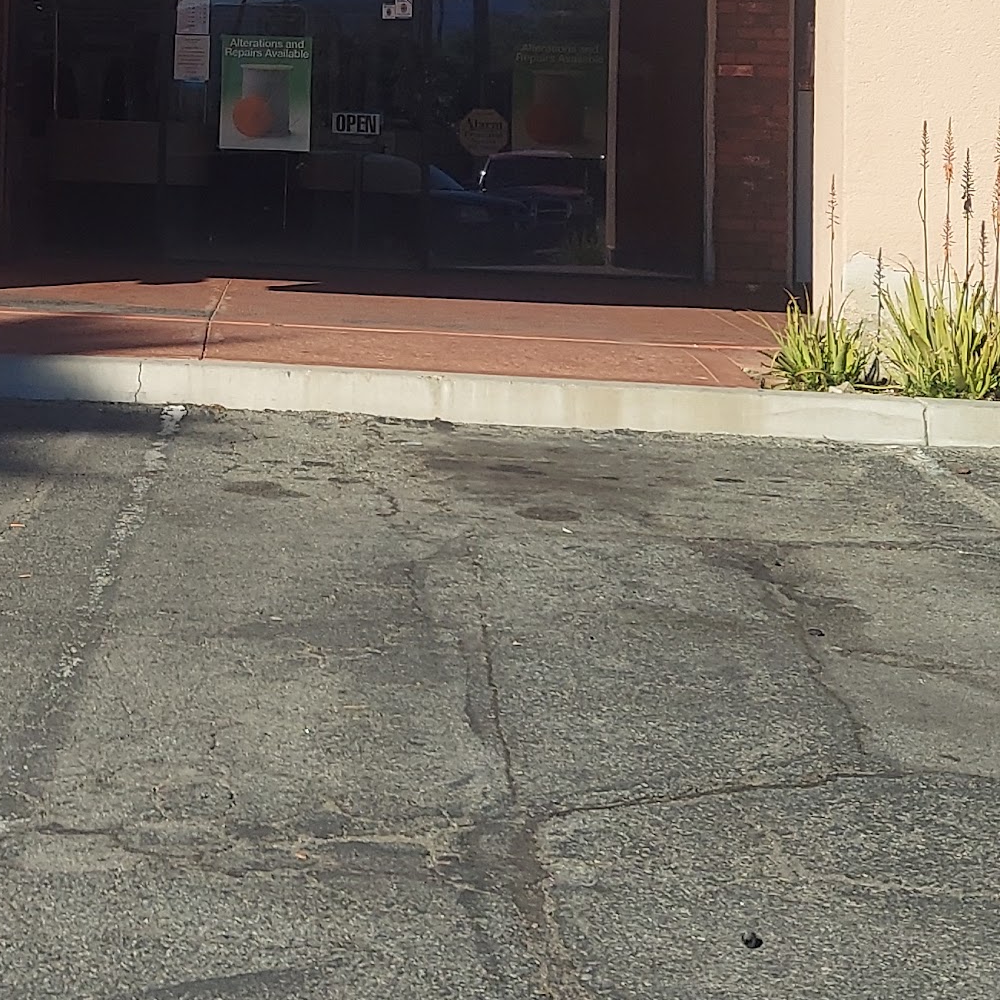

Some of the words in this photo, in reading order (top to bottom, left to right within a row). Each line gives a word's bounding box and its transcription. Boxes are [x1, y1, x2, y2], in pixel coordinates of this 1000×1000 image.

[230, 38, 284, 49] Alterations
[286, 39, 305, 49] and
[225, 47, 262, 59] Repairs
[265, 48, 309, 59] Available
[336, 114, 377, 133] OPEN
